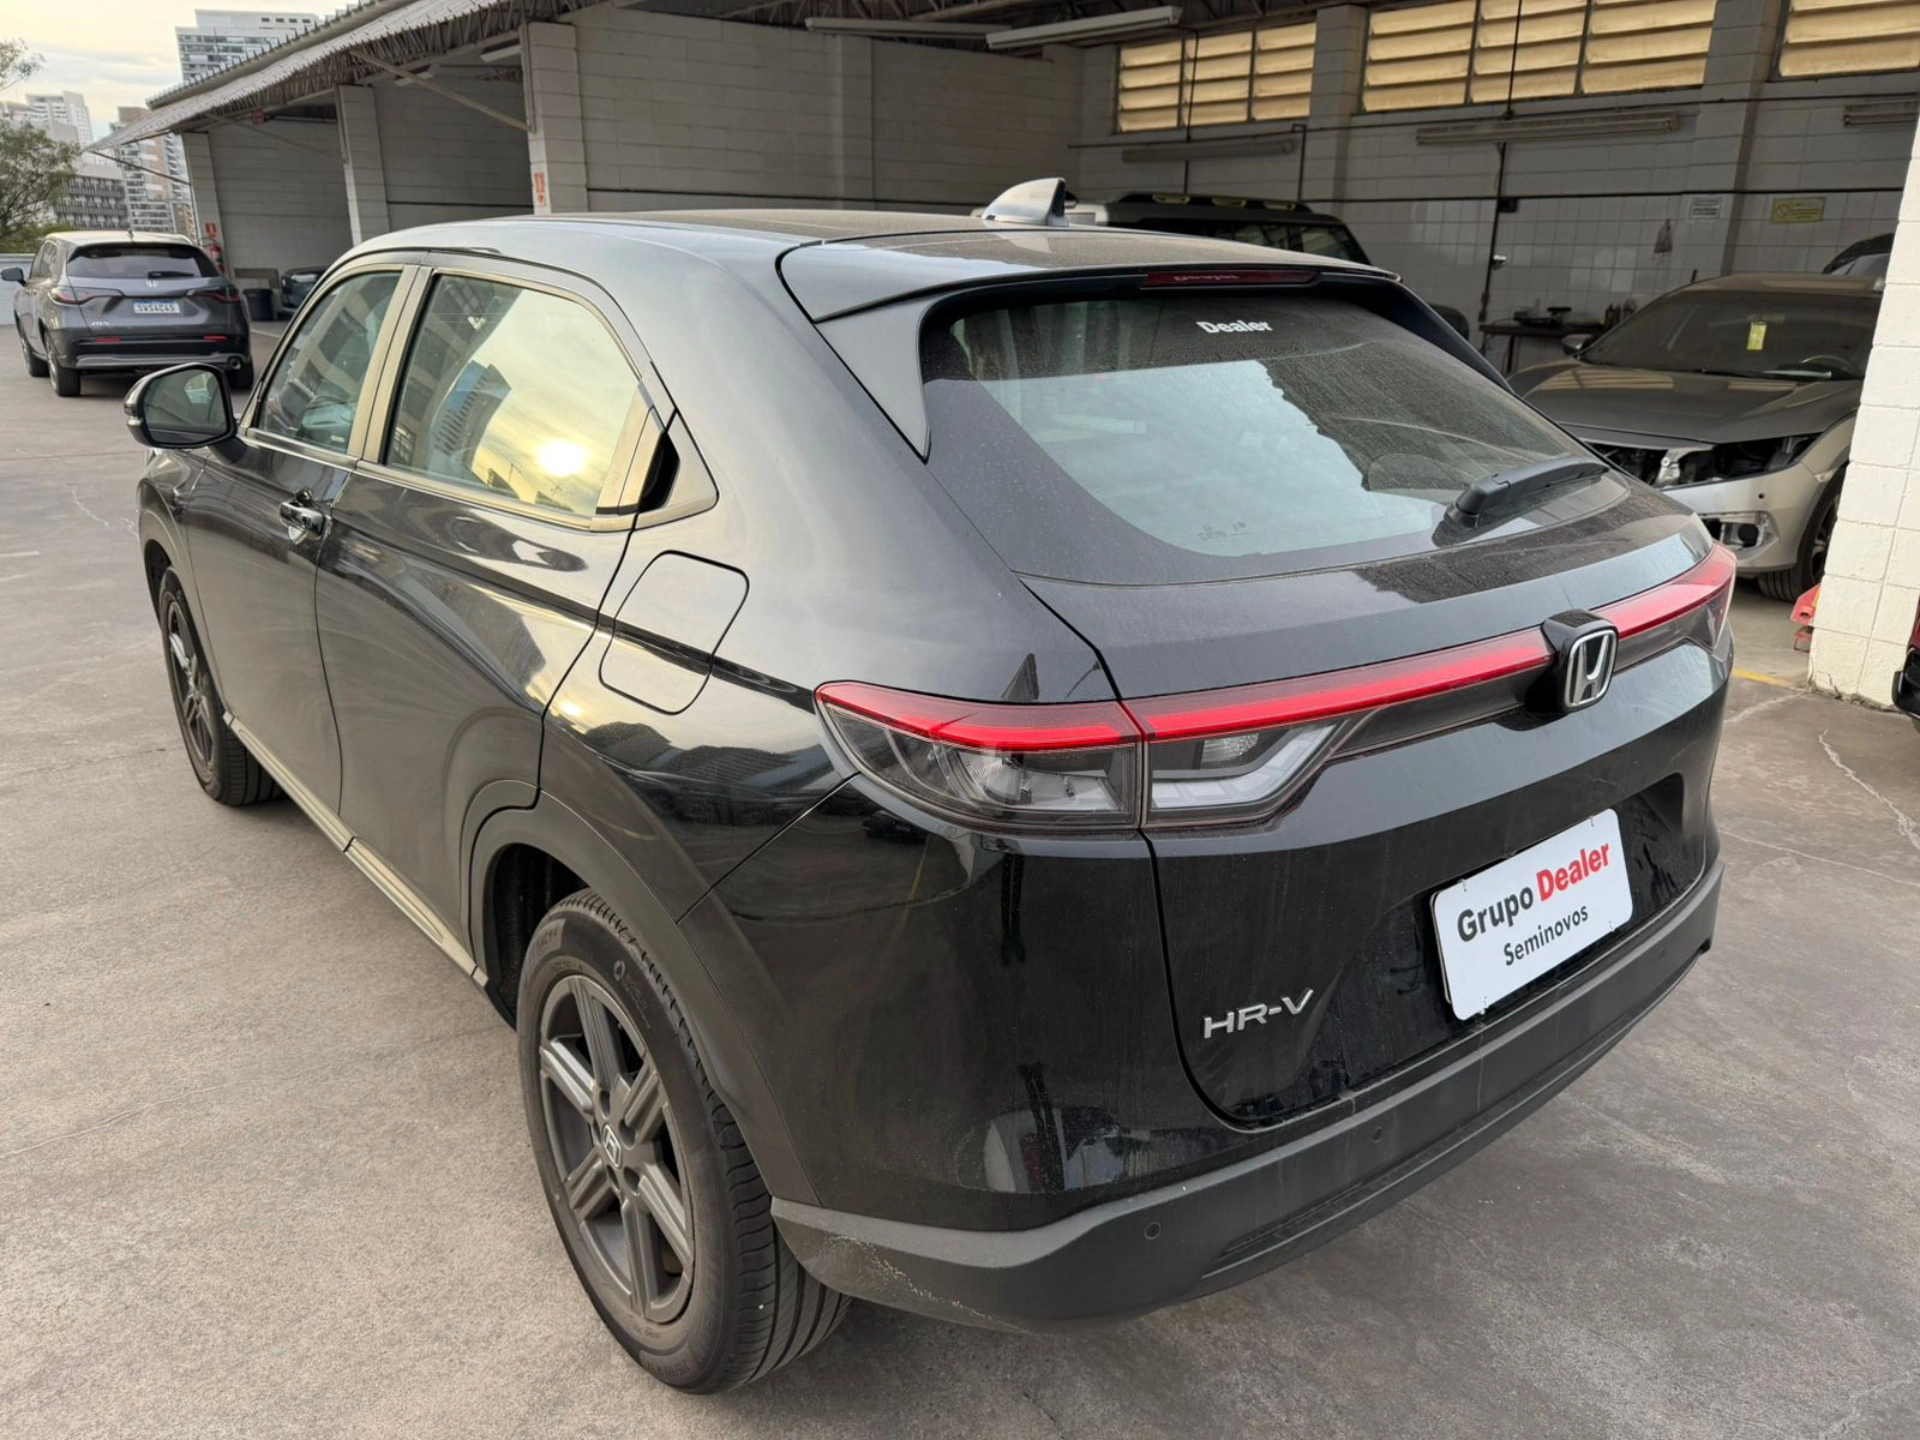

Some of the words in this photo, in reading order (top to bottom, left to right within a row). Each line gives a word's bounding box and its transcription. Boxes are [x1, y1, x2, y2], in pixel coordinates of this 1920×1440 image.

[1196, 319, 1273, 334] Dealer
[1457, 886, 1534, 942] Grupo
[1536, 842, 1610, 902] Dealer
[1503, 905, 1589, 966] Seminovos
[1203, 988, 1314, 1039] HR-V
